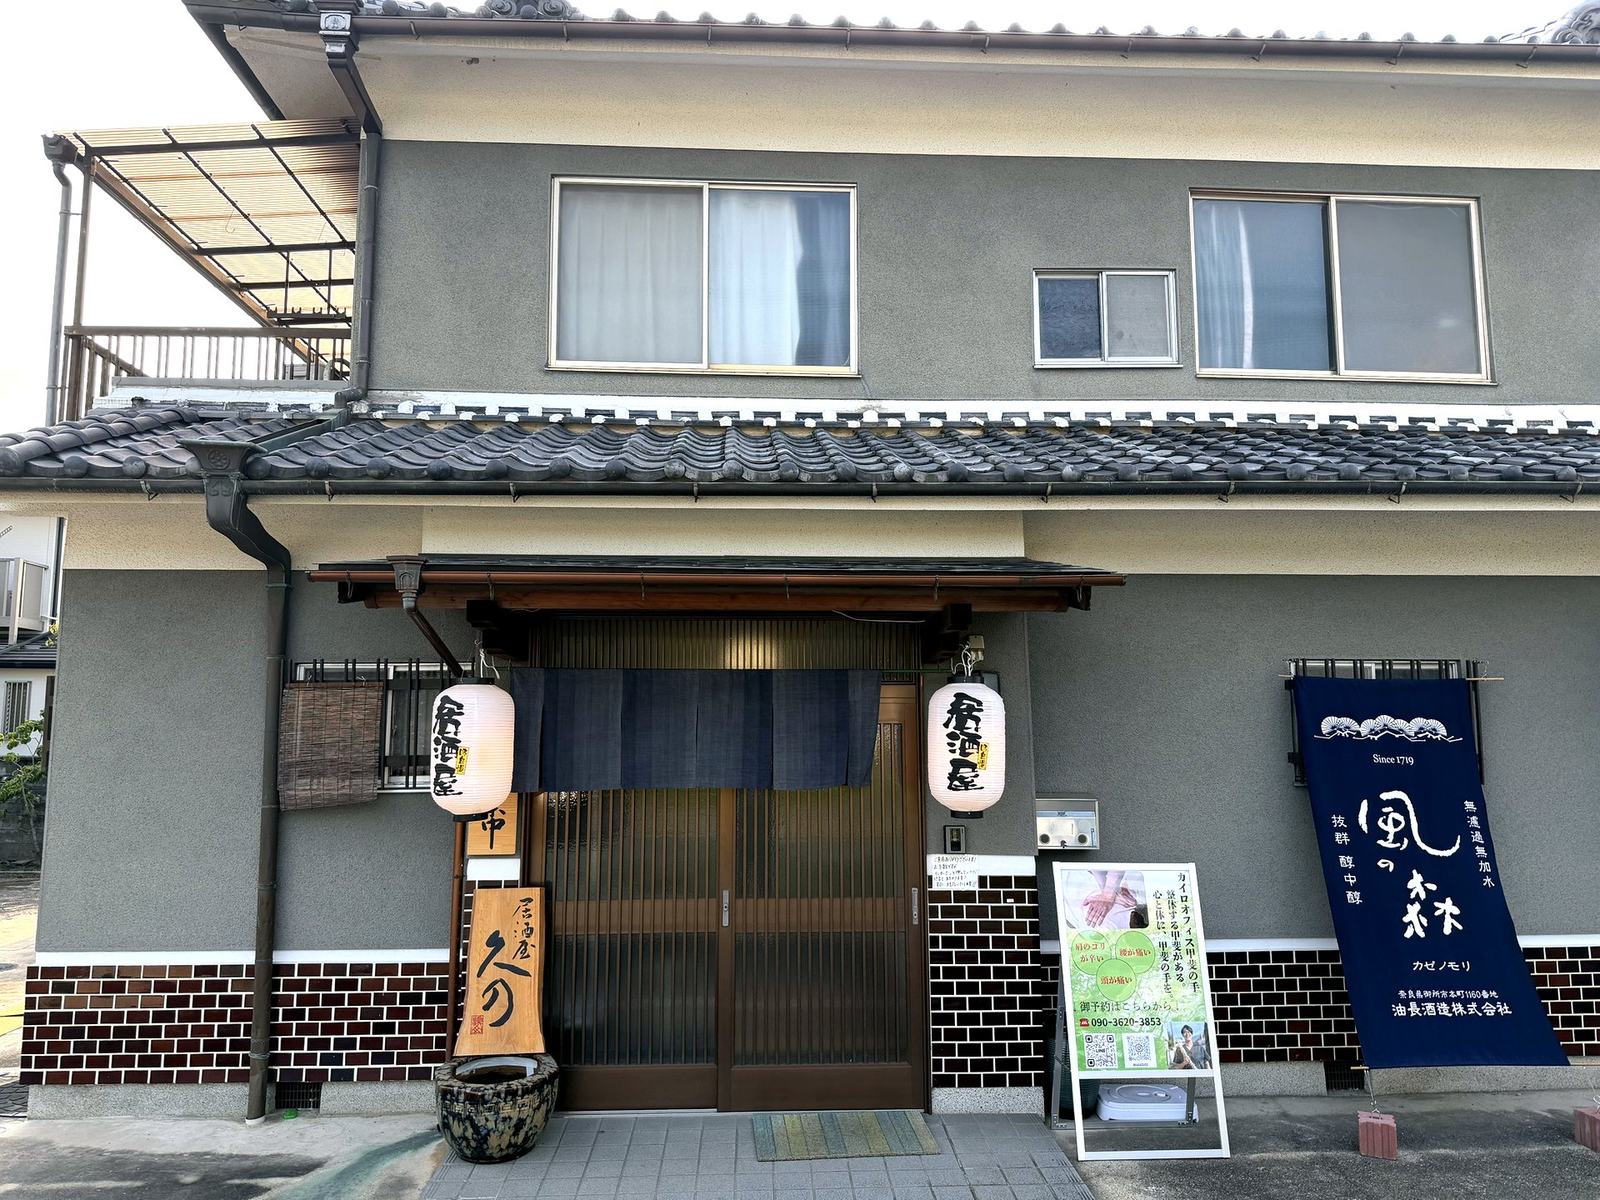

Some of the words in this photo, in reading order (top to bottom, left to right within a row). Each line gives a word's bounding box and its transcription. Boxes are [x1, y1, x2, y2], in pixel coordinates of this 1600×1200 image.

[433, 695, 465, 796] 居酒屋
[943, 692, 984, 792] 居酒屋
[1372, 754, 1395, 764] Since
[1396, 756, 1414, 766] 1719
[1331, 814, 1350, 846] 抜群
[1463, 800, 1496, 888] 無濾過無加水
[1358, 790, 1464, 939] 風の森
[512, 897, 536, 960] 居酒屋
[1178, 872, 1200, 993] カイロオフィス甲斐の手
[1119, 947, 1151, 957] 腰が痛い
[1412, 960, 1471, 972] カゼノモリ
[1100, 976, 1133, 985] 頭が痛い
[1398, 989, 1499, 999] 奈良県御所市本町1160番地
[1391, 1001, 1513, 1017] 油長酒造株式会社
[1091, 1017, 1161, 1027] 090-3620-3853
